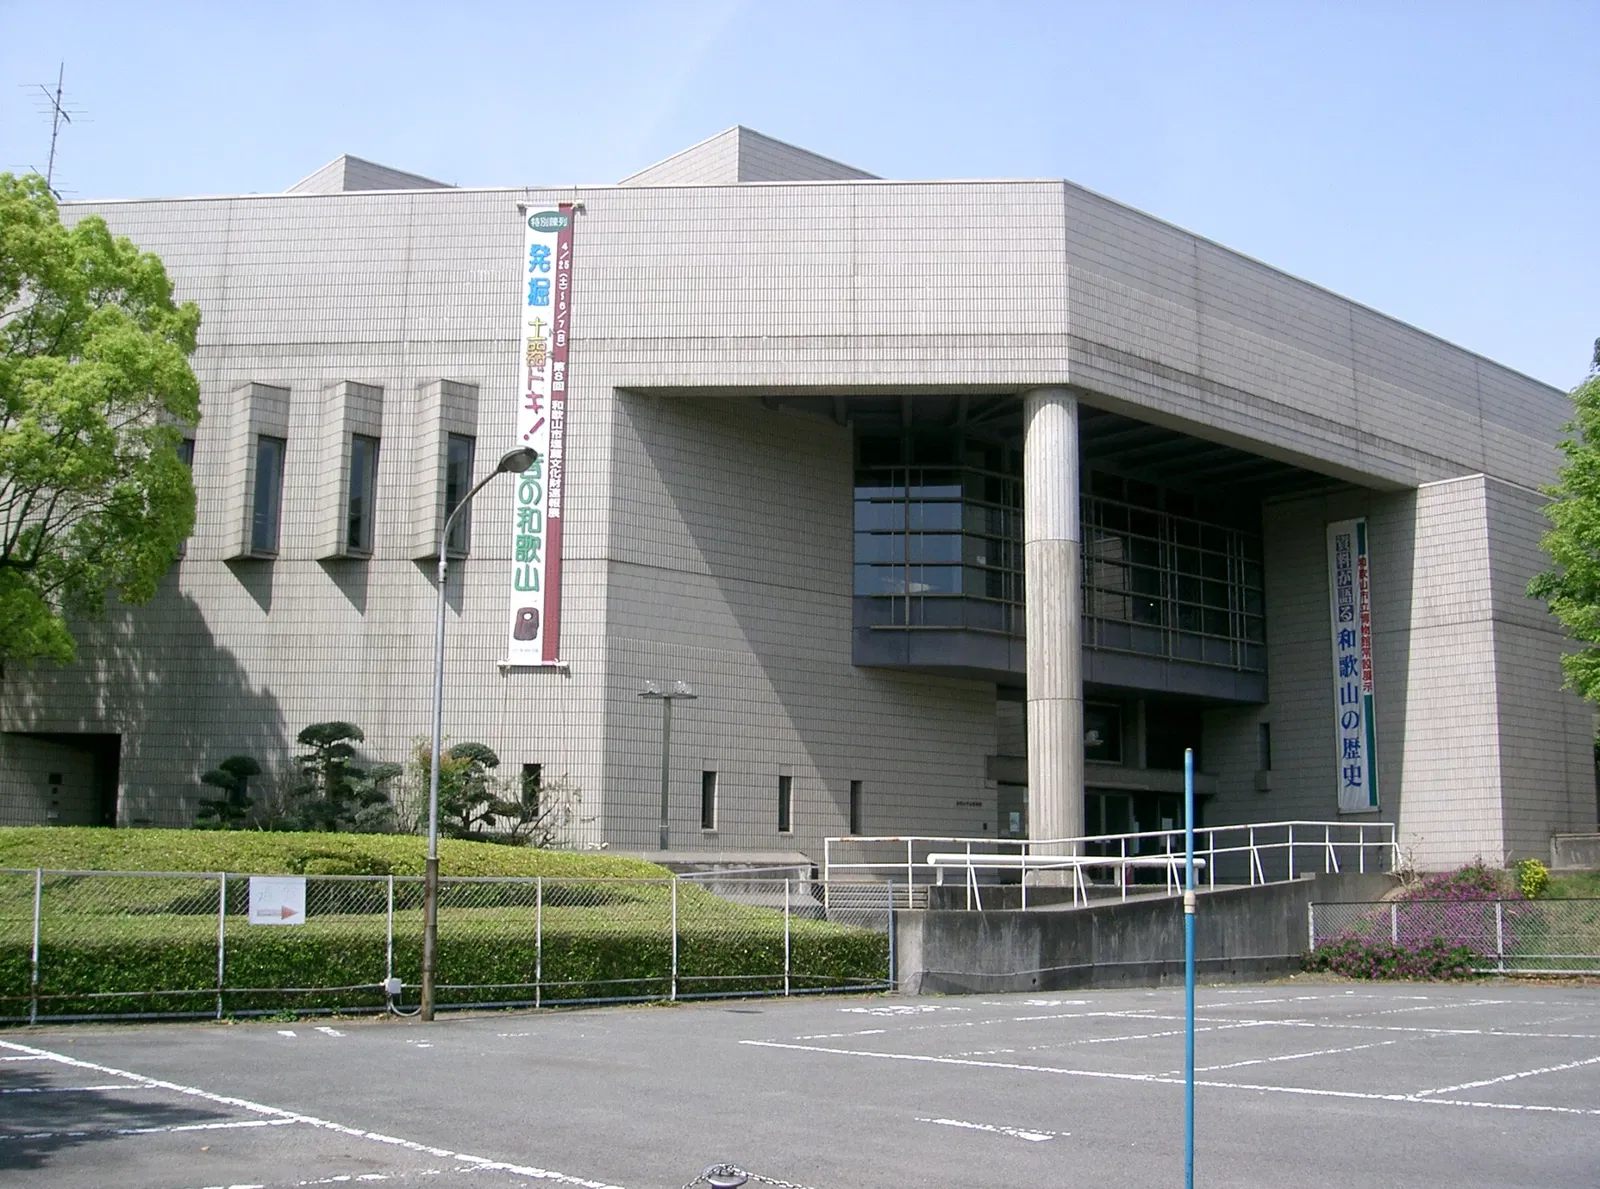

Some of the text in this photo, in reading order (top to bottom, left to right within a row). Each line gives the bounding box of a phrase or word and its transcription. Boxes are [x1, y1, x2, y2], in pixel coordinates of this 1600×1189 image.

[530, 216, 568, 227] 特別陳列
[1338, 628, 1362, 788] 和歌山の歴史
